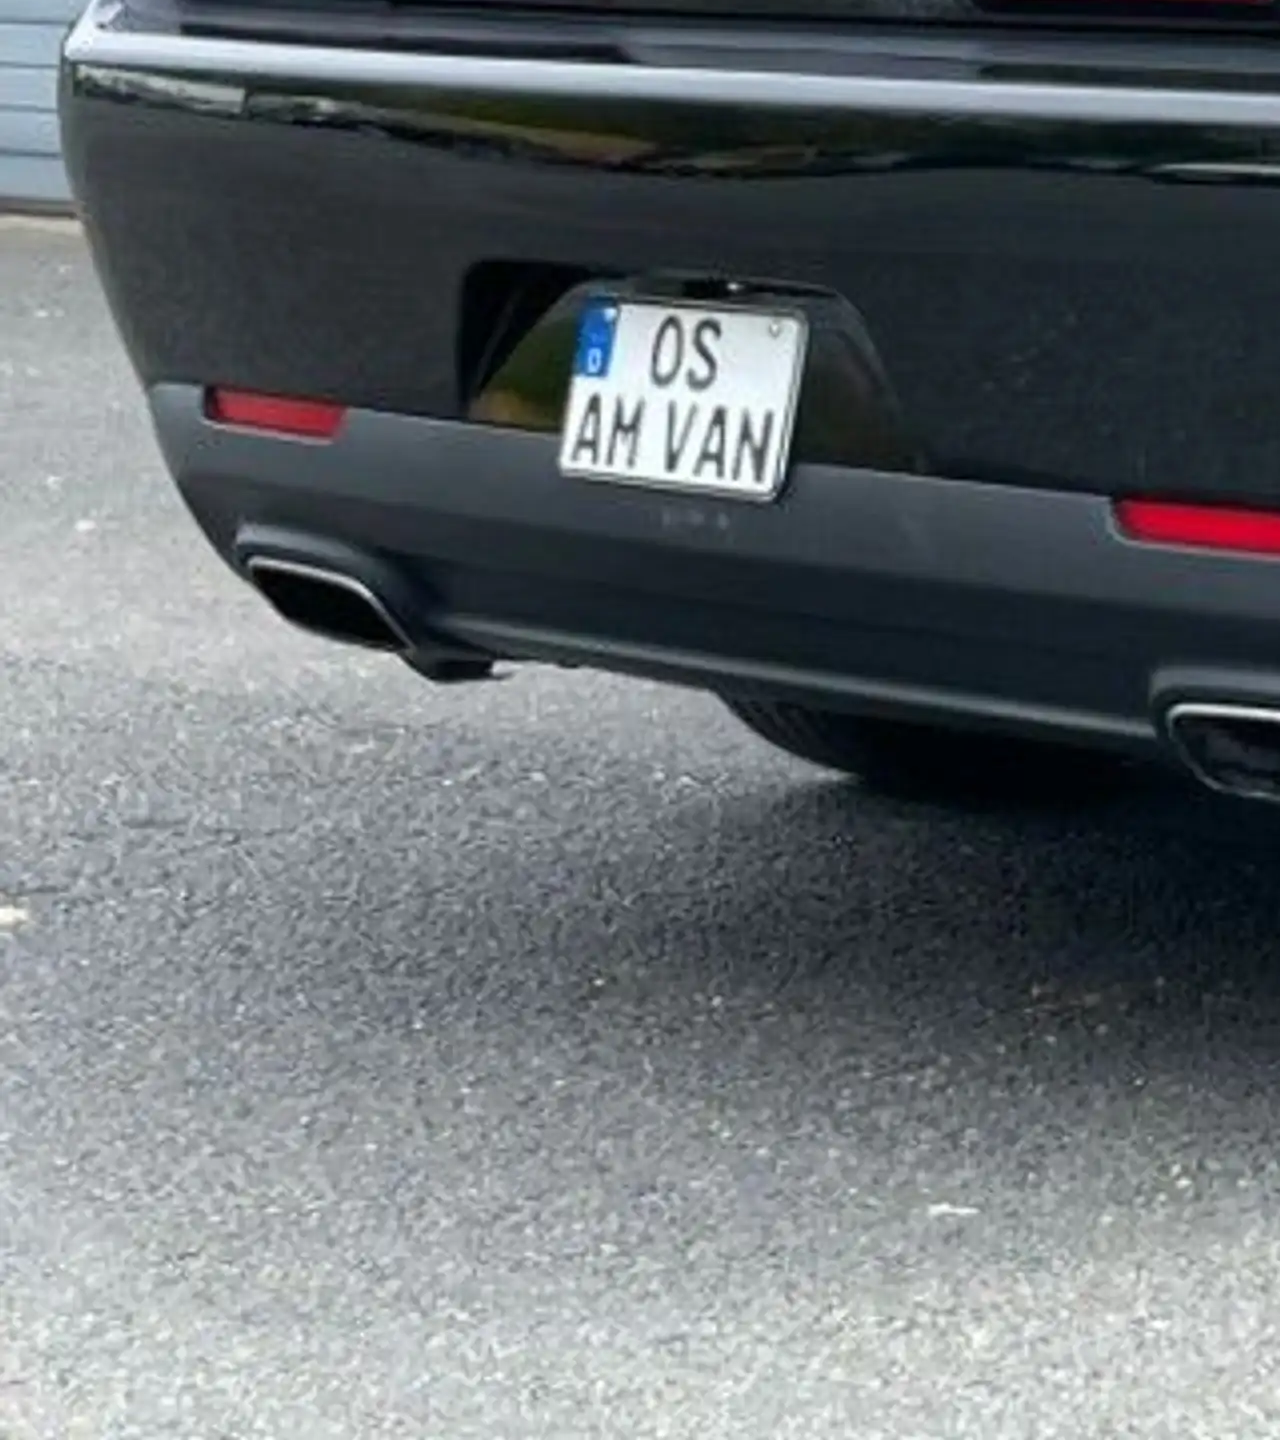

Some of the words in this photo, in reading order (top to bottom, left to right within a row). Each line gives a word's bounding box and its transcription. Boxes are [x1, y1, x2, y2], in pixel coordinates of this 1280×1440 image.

[587, 347, 601, 372] D
[650, 315, 722, 391] OS
[570, 392, 646, 469] AM
[663, 398, 775, 484] VAN
